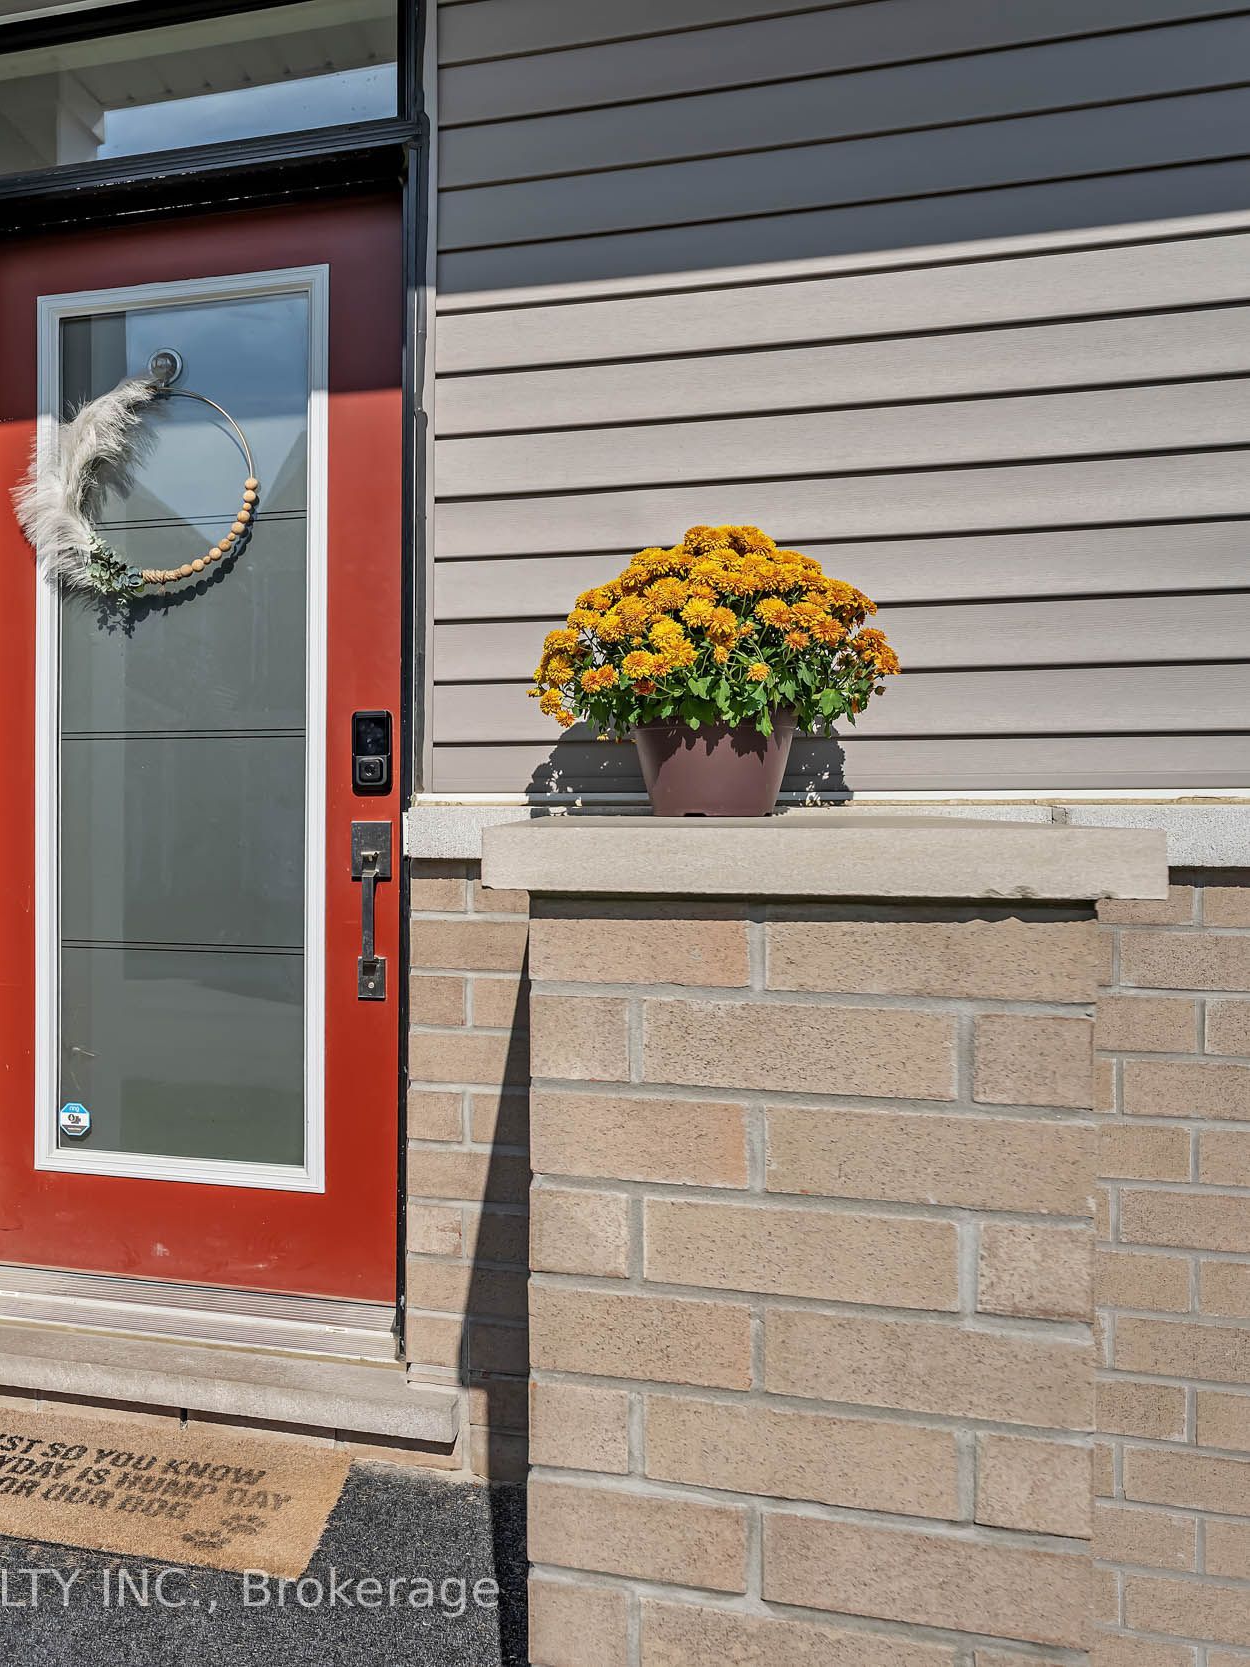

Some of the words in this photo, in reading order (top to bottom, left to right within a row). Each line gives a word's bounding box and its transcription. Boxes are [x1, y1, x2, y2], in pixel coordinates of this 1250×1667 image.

[41, 1442, 88, 1461] SO
[93, 1448, 158, 1471] YOU
[163, 1458, 267, 1486] KNOW
[41, 1482, 116, 1509] OUR
[116, 1495, 193, 1521] DOG
[75, 1466, 111, 1486] IS
[114, 1471, 218, 1500] HUMP
[224, 1487, 293, 1511] DAY
